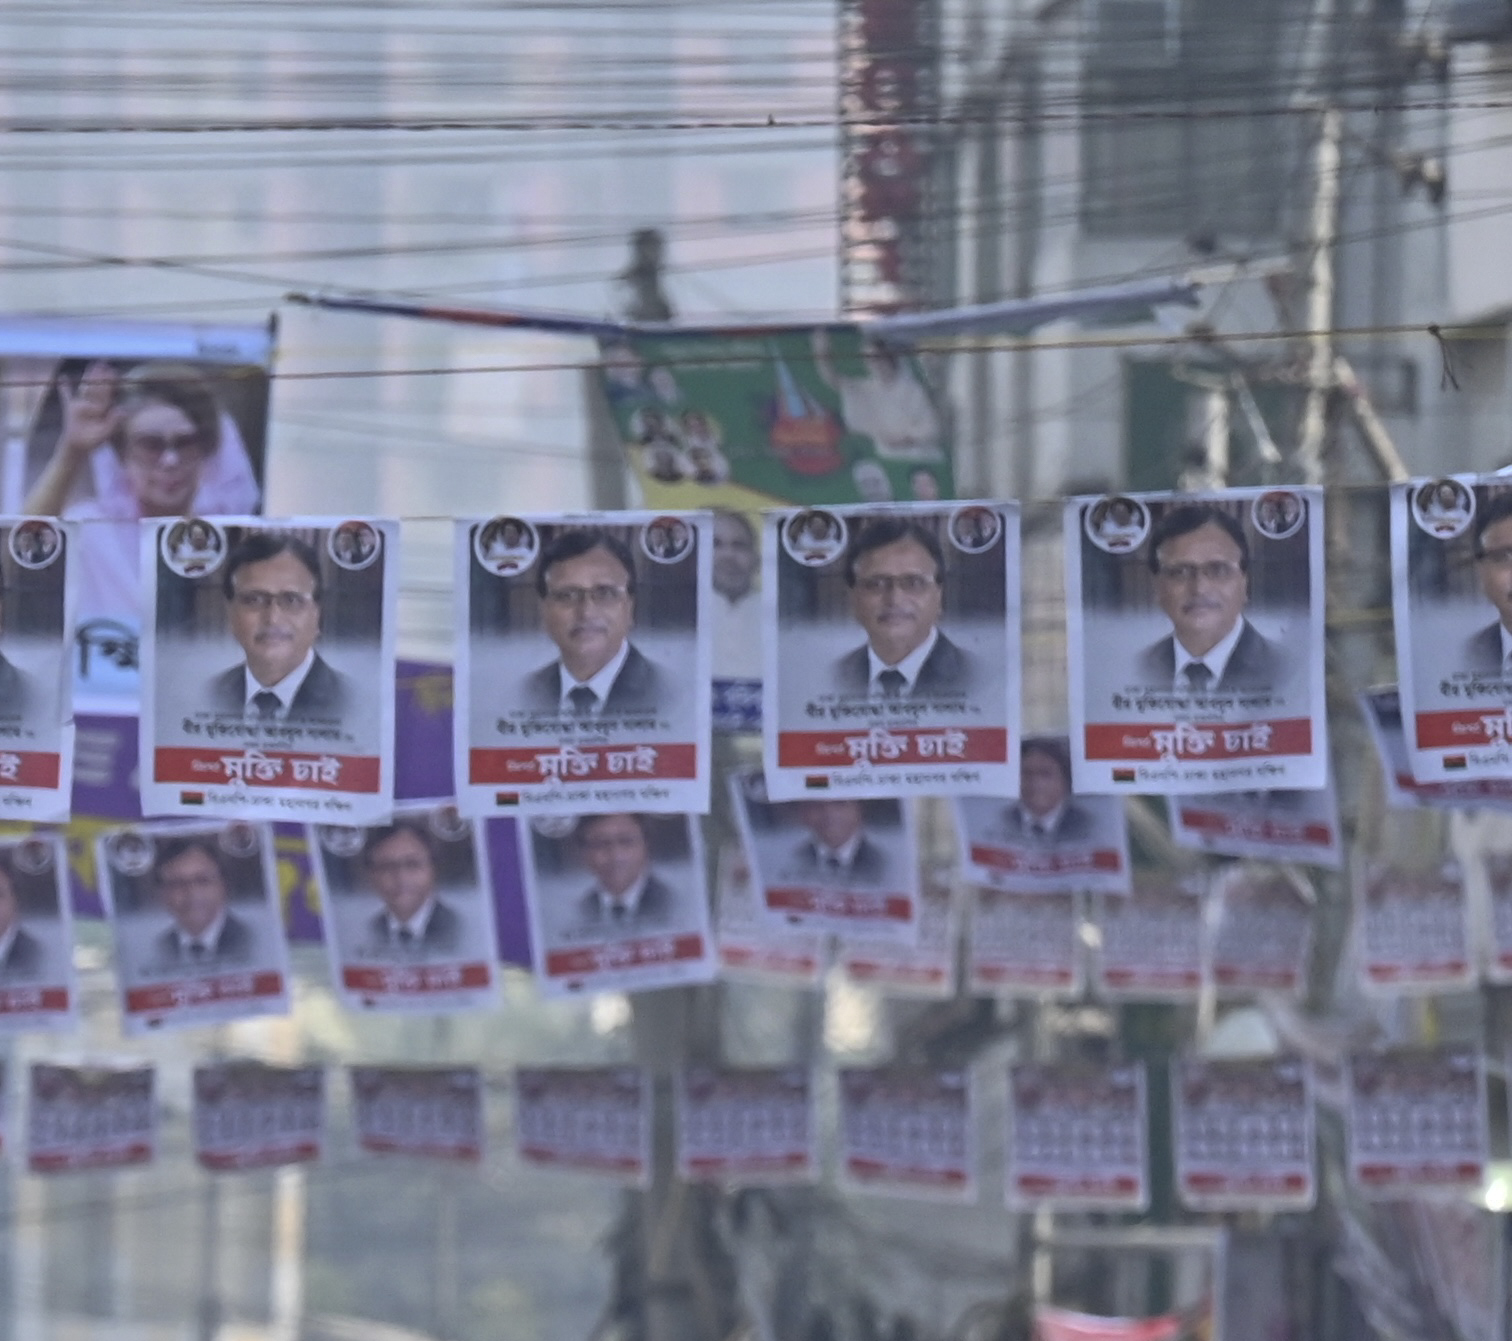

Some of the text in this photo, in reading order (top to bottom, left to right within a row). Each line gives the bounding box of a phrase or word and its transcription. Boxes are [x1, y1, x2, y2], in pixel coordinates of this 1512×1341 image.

[844, 726, 967, 771] মুক্তি চাই
[1150, 717, 1271, 763] মুক্তি চাই
[220, 747, 341, 791] মুক্তি চাই
[535, 741, 656, 788] মুক্তি চাই
